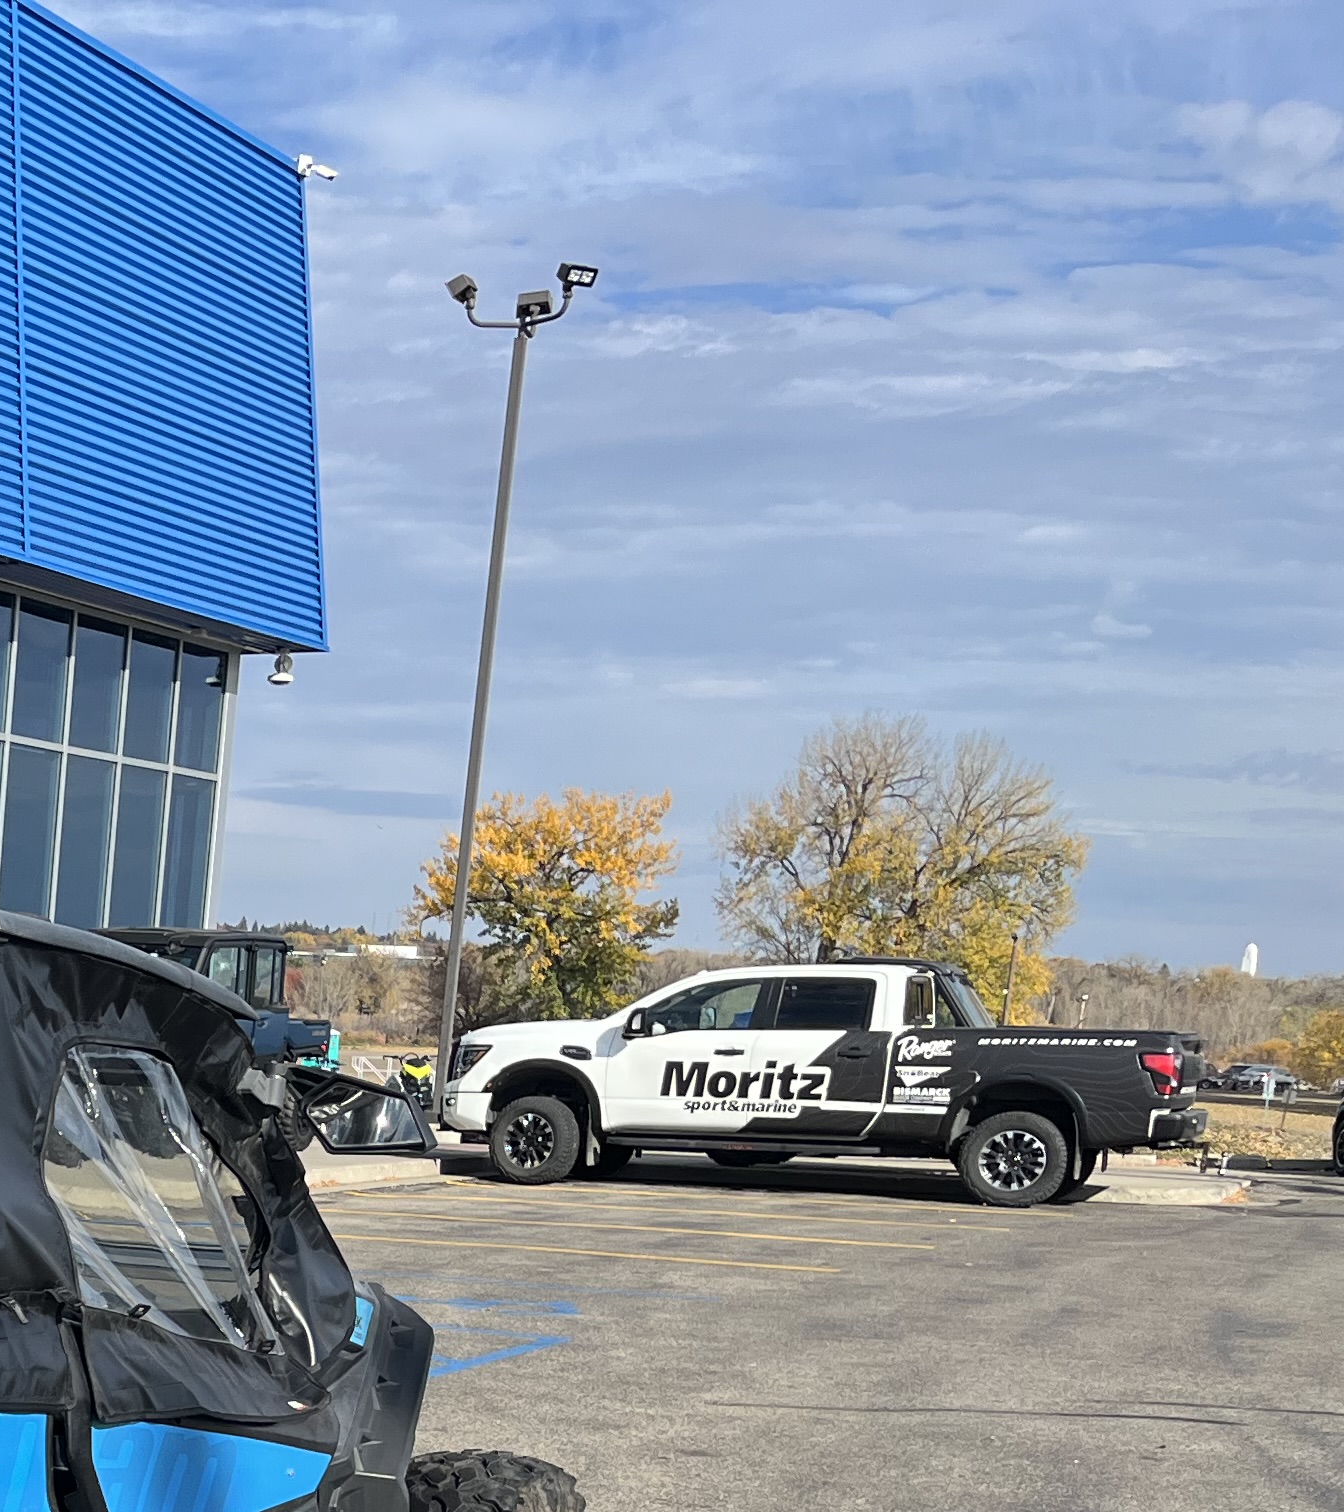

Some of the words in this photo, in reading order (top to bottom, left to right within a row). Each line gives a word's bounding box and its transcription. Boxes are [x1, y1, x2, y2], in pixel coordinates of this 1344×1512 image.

[896, 1035, 953, 1062] Ranger
[977, 1037, 1138, 1047] MORITZMARINE.COM
[659, 1060, 827, 1101] Moritz
[892, 1086, 951, 1097] BISMARCK
[682, 1099, 798, 1114] sport&marine
